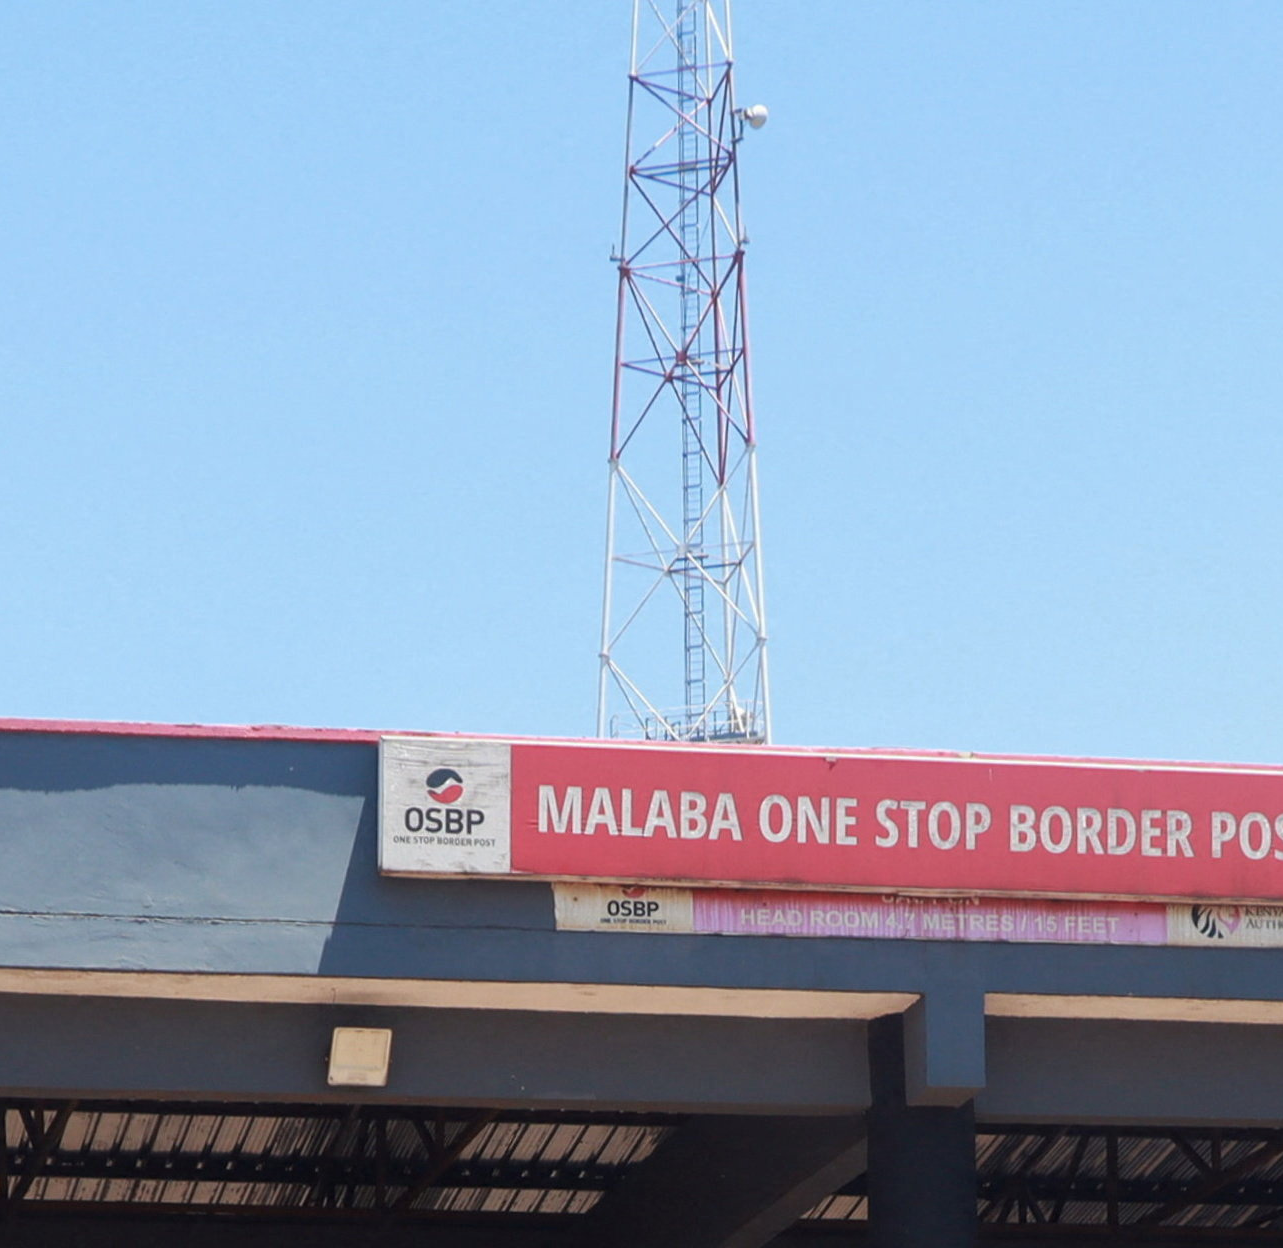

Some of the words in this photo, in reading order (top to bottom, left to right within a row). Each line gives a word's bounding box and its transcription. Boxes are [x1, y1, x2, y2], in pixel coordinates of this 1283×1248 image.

[404, 806, 485, 835] OSBP
[537, 784, 743, 842] MALABA
[758, 794, 858, 845] ONE
[874, 799, 992, 850] STOP
[1009, 804, 1194, 858] BORDER
[393, 835, 411, 845] ONE
[413, 836, 436, 845] STOP
[437, 837, 473, 847] BORDER
[474, 838, 496, 847] POST
[607, 900, 659, 917] OSBP
[740, 908, 804, 927] HEAD
[810, 910, 879, 929] ROOM
[922, 912, 1014, 932] METRES
[1034, 915, 1058, 933] 15
[1064, 916, 1120, 934] FEET
